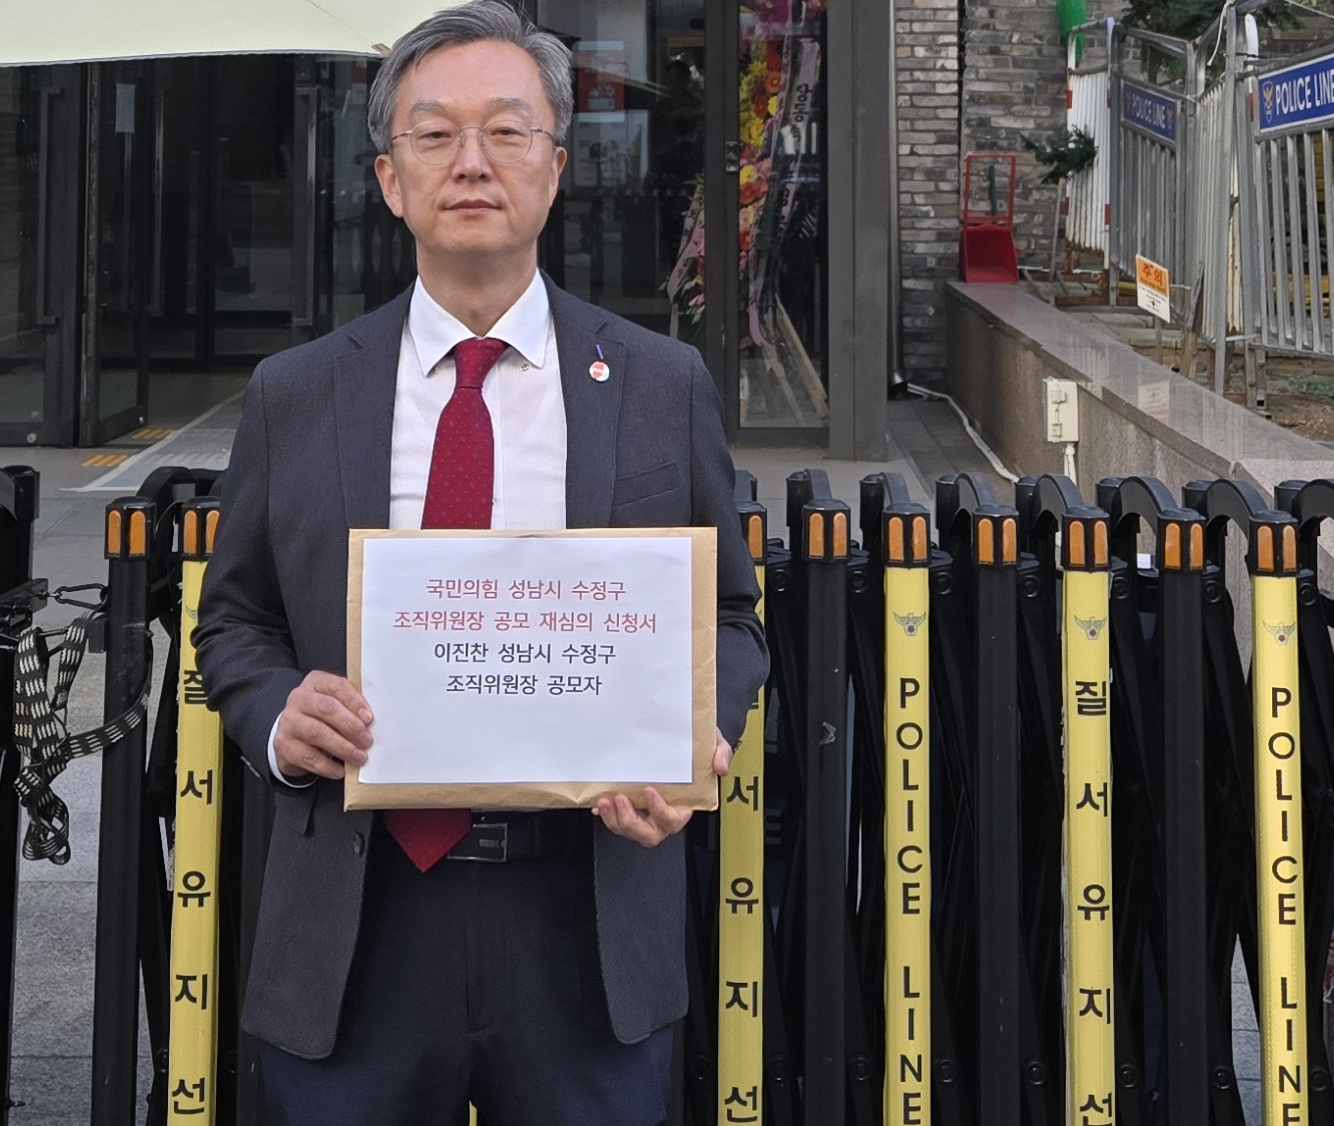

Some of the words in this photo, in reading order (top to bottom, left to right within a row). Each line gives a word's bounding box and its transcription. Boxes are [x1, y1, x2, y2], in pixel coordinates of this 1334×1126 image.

[1132, 93, 1152, 124] POLICE
[1152, 101, 1166, 130] LINE
[1274, 75, 1312, 116] POLICE
[393, 611, 485, 631] 조직위원장
[493, 611, 530, 631] 공모
[539, 611, 594, 632] 재심의
[603, 612, 657, 634] 신청서
[426, 578, 499, 600] 국민의힘
[508, 579, 562, 601] 성남시
[571, 580, 627, 602] 수정구
[434, 642, 489, 664] 이진찬
[497, 643, 552, 664] 성남시
[561, 644, 616, 665] 수정구
[446, 674, 538, 695] 조직위원장
[547, 675, 602, 696] 공모자
[895, 677, 923, 915] POLICE
[1268, 686, 1298, 926] POLICE
[724, 701, 760, 1124] 서유지선
[1074, 679, 1114, 1126] 질서유지선
[900, 965, 924, 1124] LINE
[1279, 977, 1302, 1126] LINE
